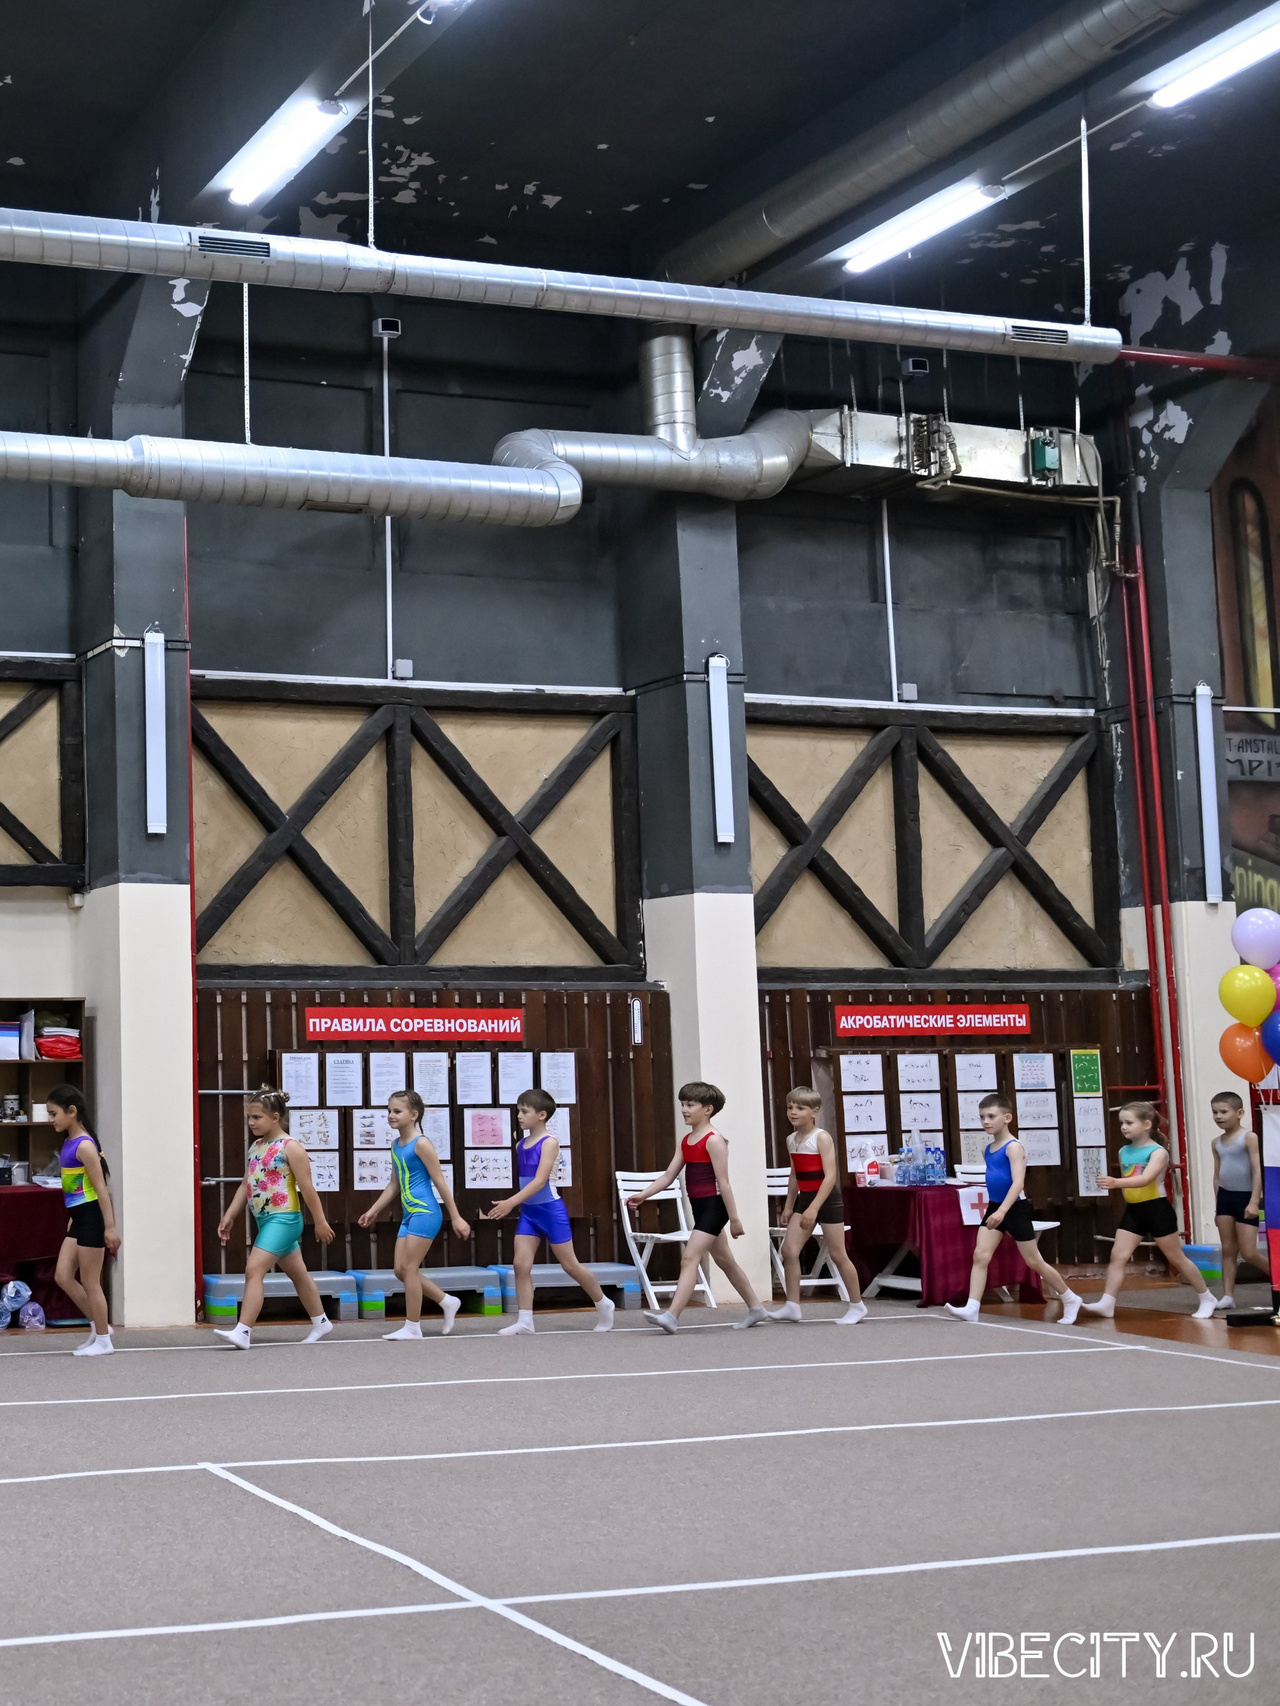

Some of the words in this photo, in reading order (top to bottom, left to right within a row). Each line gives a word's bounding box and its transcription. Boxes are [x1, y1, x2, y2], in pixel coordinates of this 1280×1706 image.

[309, 1018, 387, 1032] ПРАВИЛА
[390, 1016, 521, 1033] СОРЕВНОВАНИЙ
[839, 1014, 955, 1029] АКРОБАТИЧЕСКИЕ
[956, 1014, 1027, 1028] ЭЛЕМЕНТЫ
